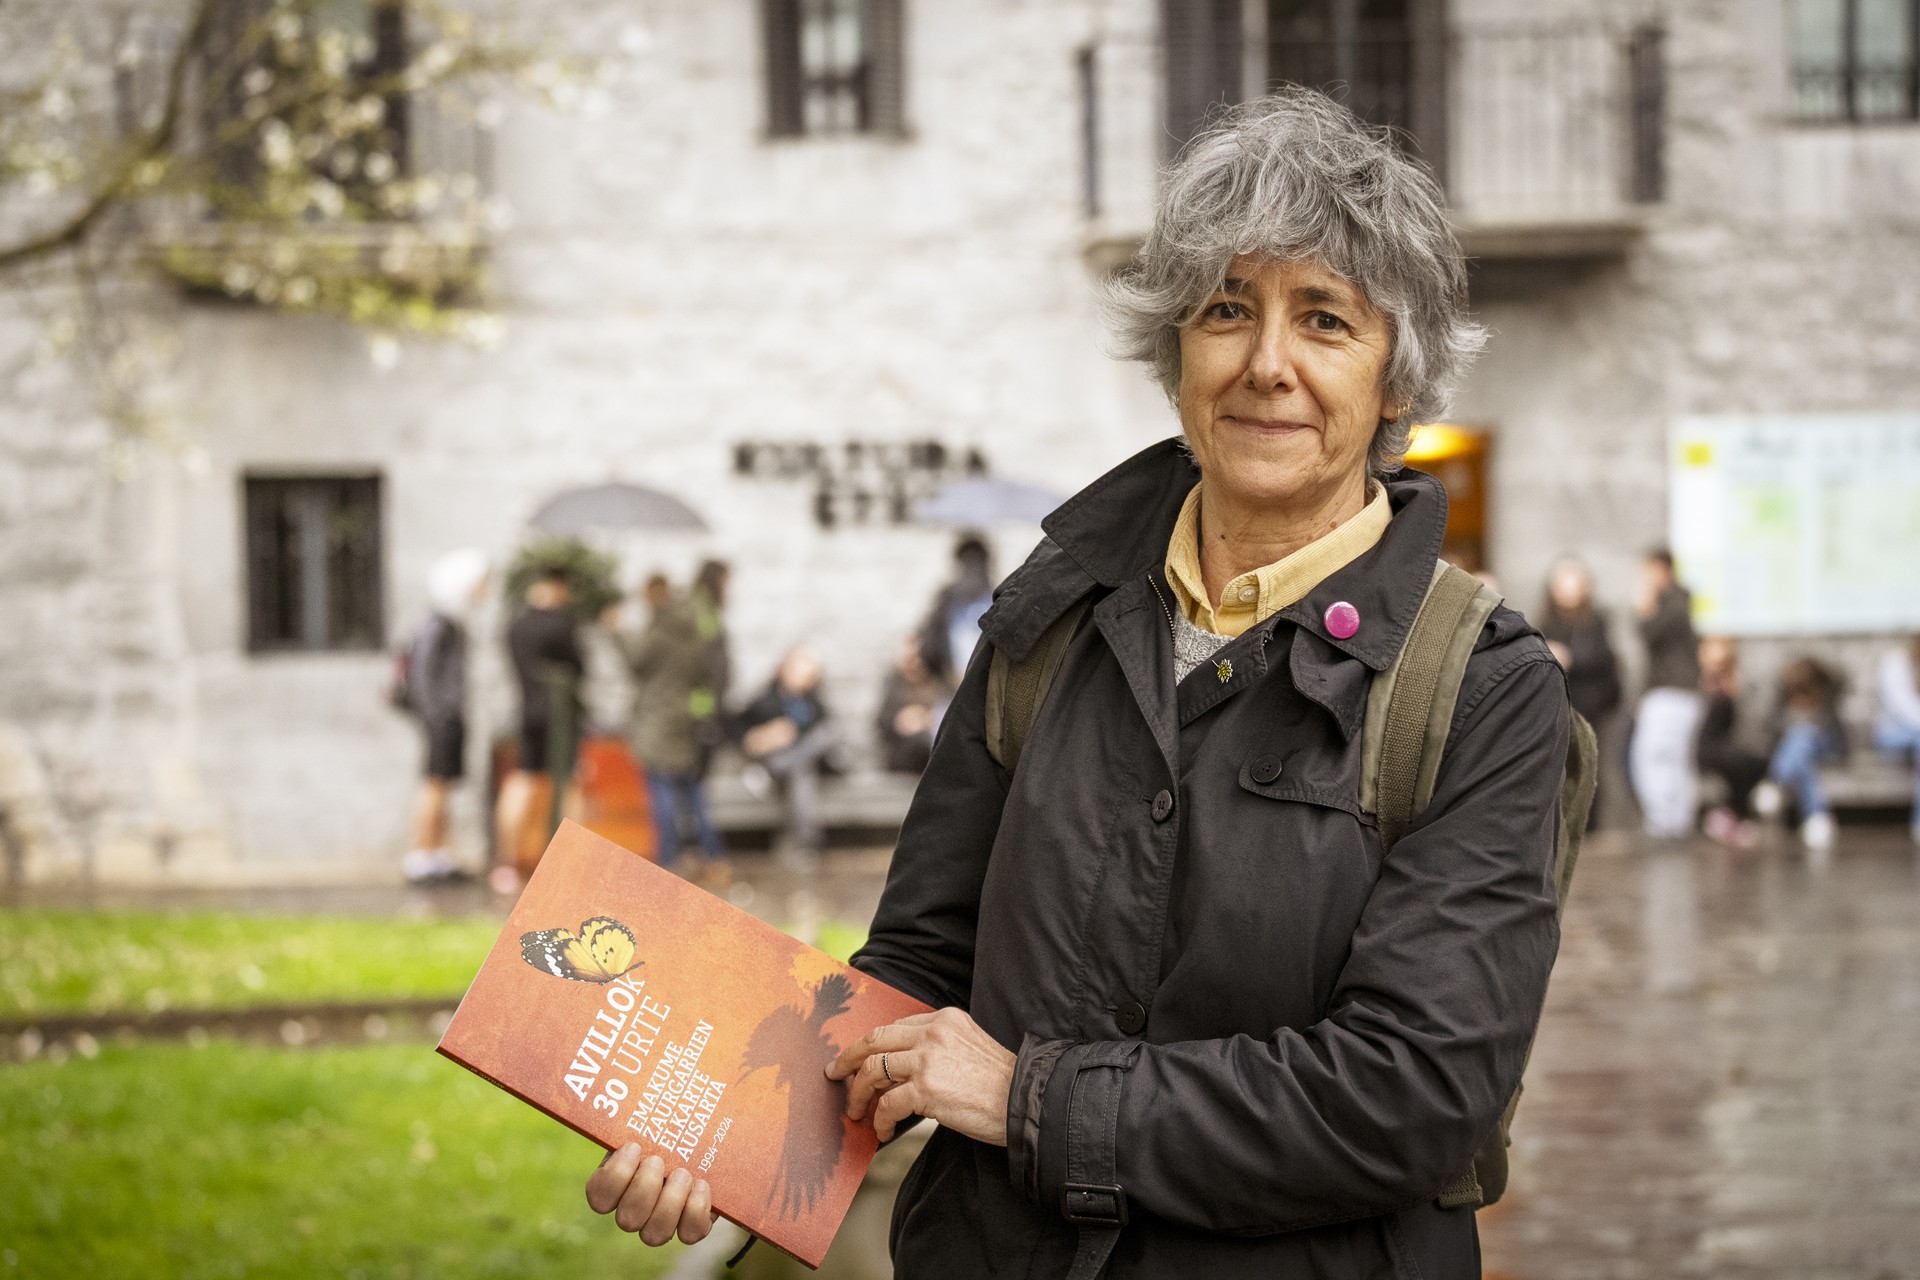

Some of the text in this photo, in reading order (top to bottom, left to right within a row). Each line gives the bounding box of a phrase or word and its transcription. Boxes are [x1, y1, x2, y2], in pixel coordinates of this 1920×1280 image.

[563, 974, 646, 1102] AVILLOK
[593, 995, 671, 1119] 30 URTE
[626, 1040, 684, 1134] EMAKUME
[642, 1018, 714, 1144] ZAURGARRIEN
[657, 1069, 711, 1153] ELKARTE
[676, 1080, 727, 1163] AUSARTA
